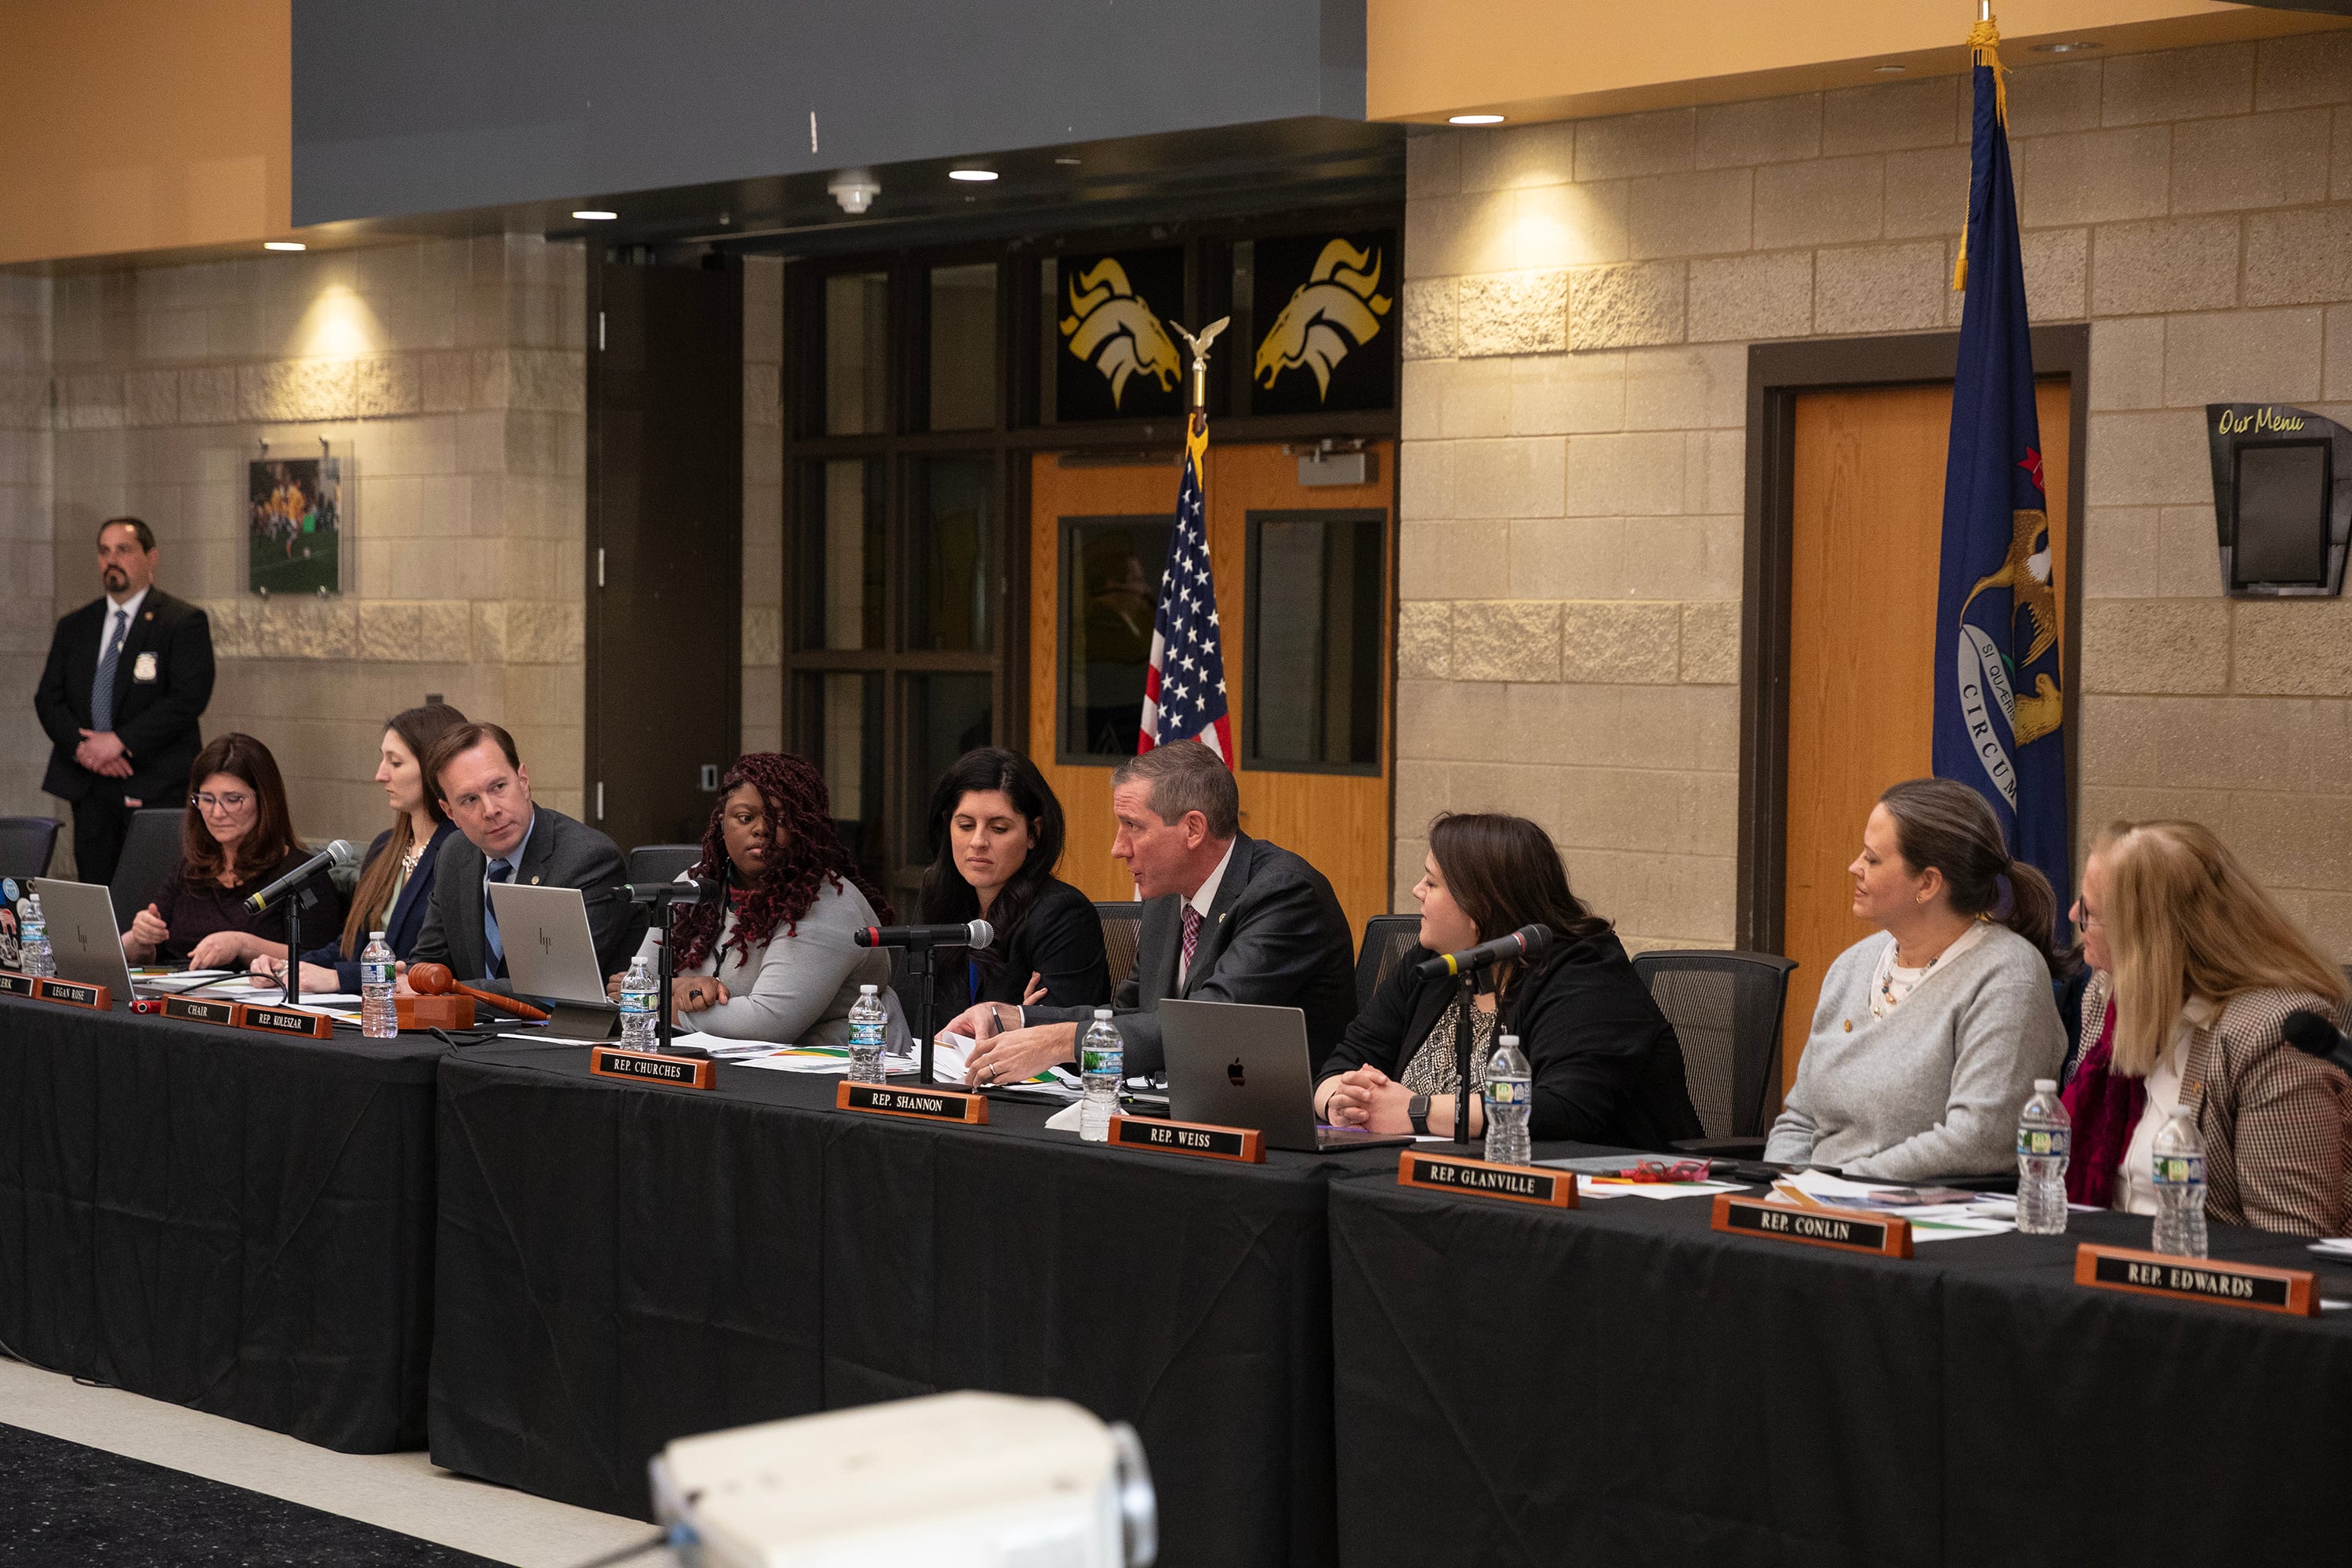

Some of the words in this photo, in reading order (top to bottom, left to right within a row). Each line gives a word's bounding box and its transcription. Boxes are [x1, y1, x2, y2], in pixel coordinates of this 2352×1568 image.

[2219, 409, 2253, 434] Our
[2255, 407, 2305, 434] Menu
[1982, 643, 1994, 658] SI
[1963, 684, 2016, 800] CIRCUM
[52, 985, 71, 998] LEGAN
[71, 989, 85, 1000] ROSE
[187, 1005, 208, 1018] CHAIR
[259, 1013, 271, 1025] REP.
[274, 1015, 302, 1029] KOLESZAR
[614, 1058, 631, 1072] REP.
[634, 1061, 681, 1078] CHURCHES
[872, 1093, 892, 1106] REP.
[896, 1096, 943, 1112] SHANNON
[1150, 1128, 1172, 1143] REP.
[1178, 1131, 1210, 1148] WEISS
[1430, 1165, 1455, 1182] REP.
[1461, 1170, 1536, 1194] GLANVILLE
[1761, 1211, 1789, 1232] REP.
[1795, 1218, 1850, 1240] CONLIN
[2128, 1262, 2162, 1286] REP.
[2170, 1269, 2254, 1298] EDWARDS
